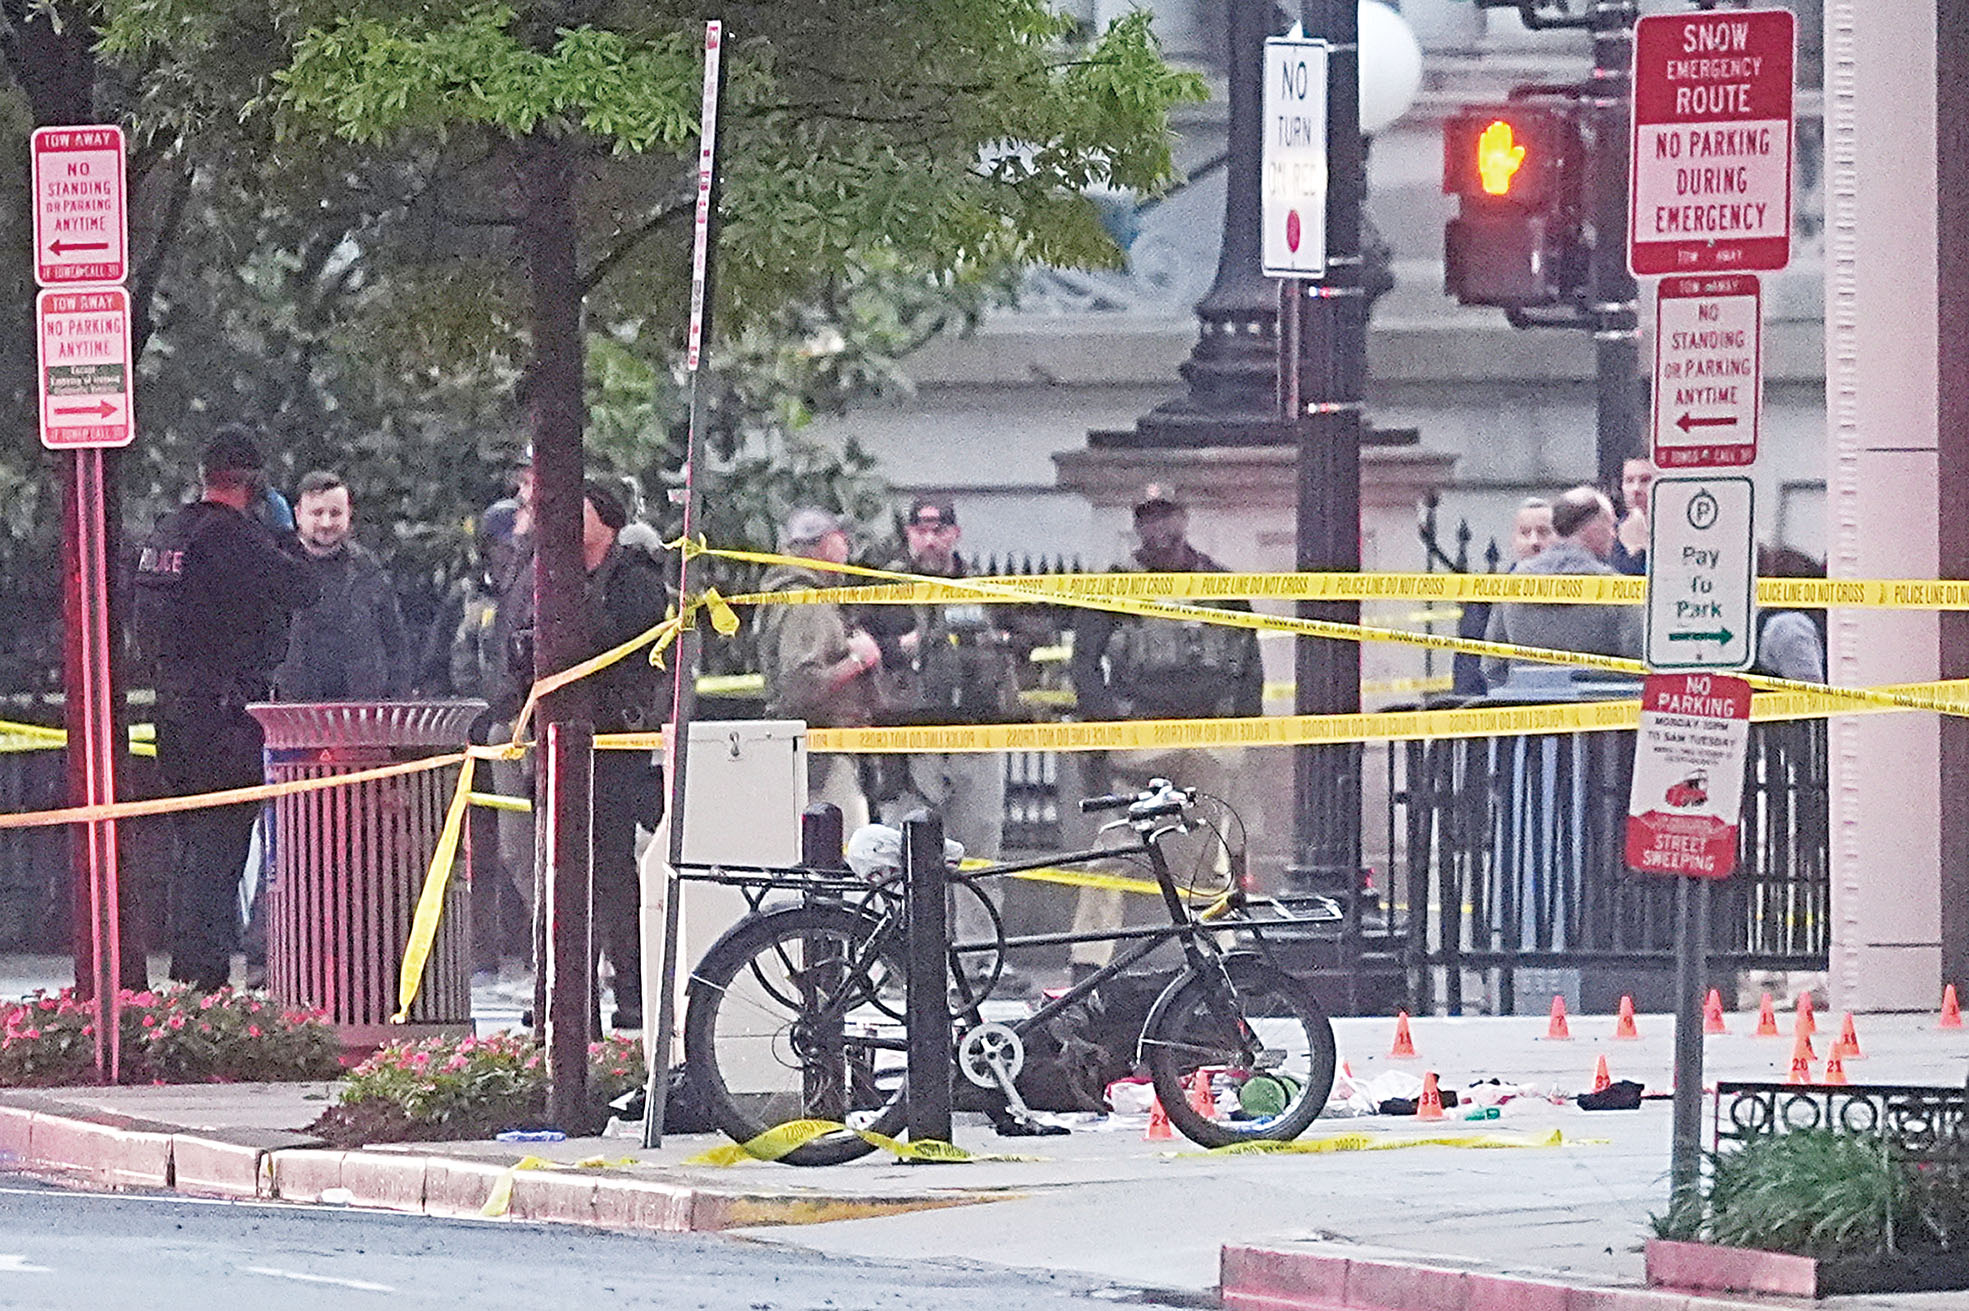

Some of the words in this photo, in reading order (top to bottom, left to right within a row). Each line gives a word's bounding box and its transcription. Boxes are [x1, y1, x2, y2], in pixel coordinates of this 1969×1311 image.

[1683, 22, 1749, 53] SNOW
[1667, 57, 1763, 80] EMERGENCY
[1281, 61, 1308, 101] NO
[1676, 84, 1752, 115] ROUTE
[1277, 115, 1312, 148] TURN
[1656, 132, 1681, 159] NO
[1689, 128, 1770, 158] PARKING
[67, 162, 90, 177] NO
[48, 180, 111, 197] STANDING
[1676, 167, 1747, 195] DURING
[63, 198, 111, 213] PARKING
[55, 215, 106, 232] ANYTIME
[1656, 203, 1767, 233] EMERGENCY
[1699, 303, 1719, 322] NO
[47, 320, 63, 337] NO
[69, 318, 121, 336] PARKING
[59, 341, 111, 358] ANYTIME
[1672, 330, 1745, 350] STANDING
[1684, 358, 1752, 378] PARKING
[1675, 386, 1738, 405] ANYTIME
[1682, 546, 1719, 569] Pay
[1070, 578, 1096, 595] POLICE
[1096, 578, 1116, 595] LINE
[1117, 578, 1129, 595] DO
[1130, 577, 1146, 594] NOT
[1147, 577, 1174, 595] CROSS
[1201, 577, 1231, 594] POLICE
[1231, 577, 1249, 594] LINE
[1250, 577, 1262, 594] DO
[1263, 577, 1280, 594] NOT
[1281, 577, 1309, 594] CROSS
[1336, 577, 1366, 594] POLICE
[1366, 577, 1385, 594] LINE
[1385, 577, 1399, 594] DO
[1399, 577, 1416, 594] NOT
[1417, 577, 1445, 595] CROSS
[1473, 578, 1503, 596] POLICE
[1503, 578, 1521, 596] LINE
[1522, 579, 1535, 597] DO
[1536, 579, 1554, 597] NOT
[1555, 579, 1584, 598] CROSS
[1612, 580, 1642, 599] POLICE
[1758, 583, 1782, 602] OLICE
[1784, 583, 1803, 602] LINE
[1804, 583, 1817, 602] DO
[1818, 583, 1835, 602] NOT
[1836, 583, 1865, 603] CROSS
[1894, 585, 1923, 604] POLICE
[1925, 585, 1944, 604] LINE
[1946, 585, 1959, 604] DO
[1676, 600, 1722, 619] Park
[1686, 676, 1711, 695] NO
[1657, 693, 1735, 719] PARKING
[1655, 833, 1707, 853] STREET
[1642, 849, 1715, 873] SWEEPING
[1792, 1057, 1808, 1072] 20
[1827, 1060, 1842, 1074] 21
[1422, 1091, 1438, 1105] 33
